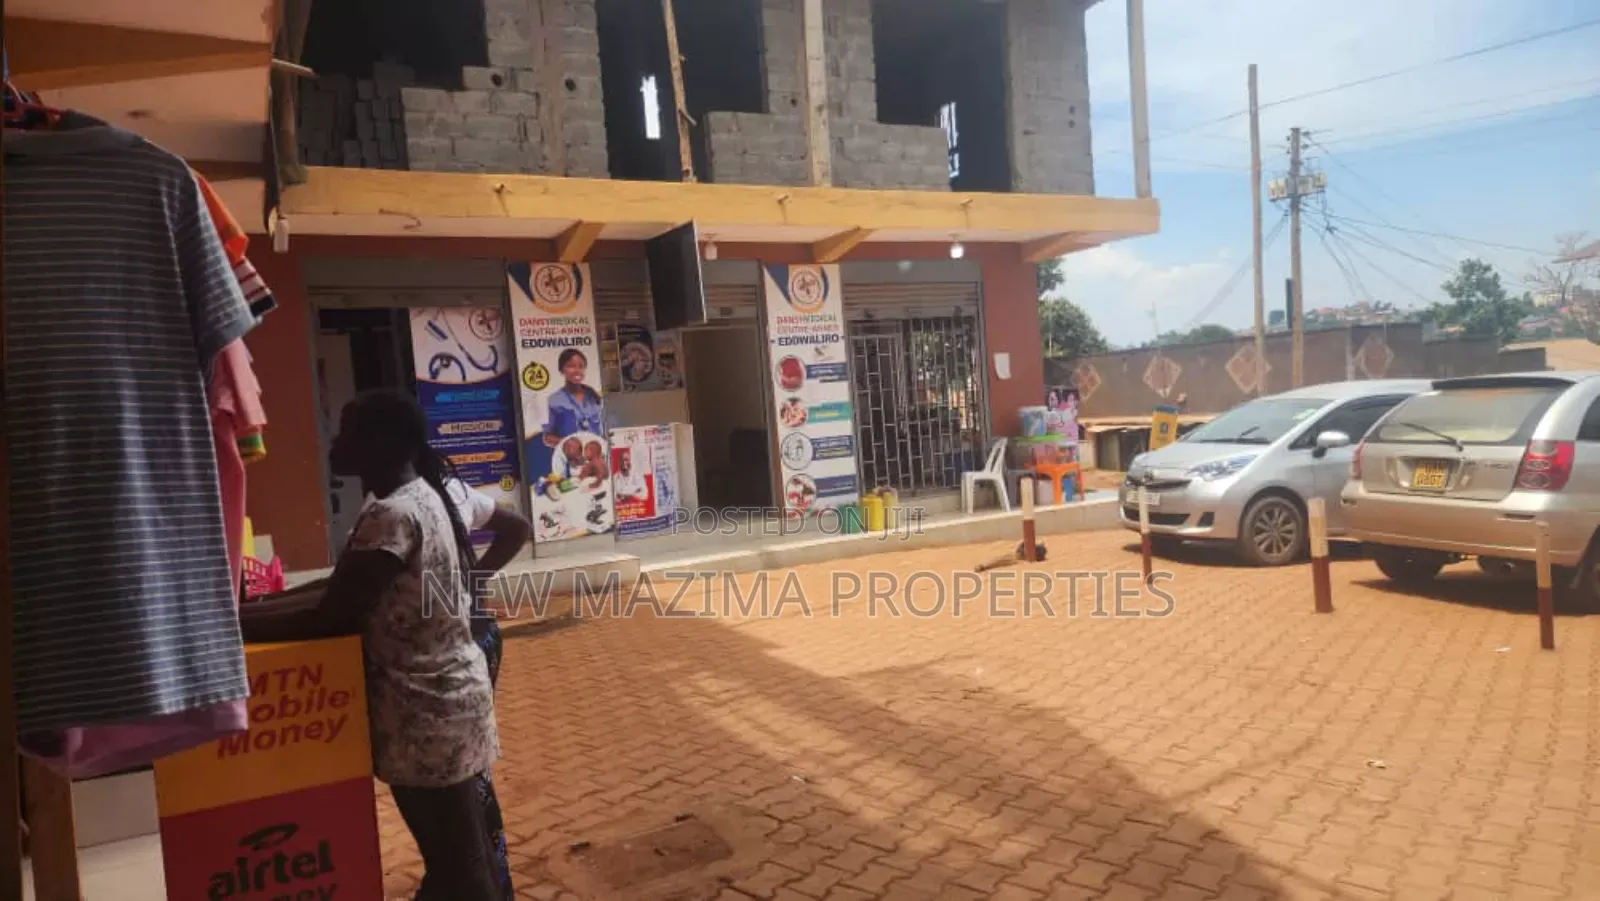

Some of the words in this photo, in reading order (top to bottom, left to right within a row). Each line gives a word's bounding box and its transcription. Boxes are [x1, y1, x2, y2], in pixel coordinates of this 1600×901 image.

[527, 369, 543, 382] 24
[248, 687, 351, 723] obile
[217, 713, 348, 759] Money
[208, 838, 335, 901] airtel
